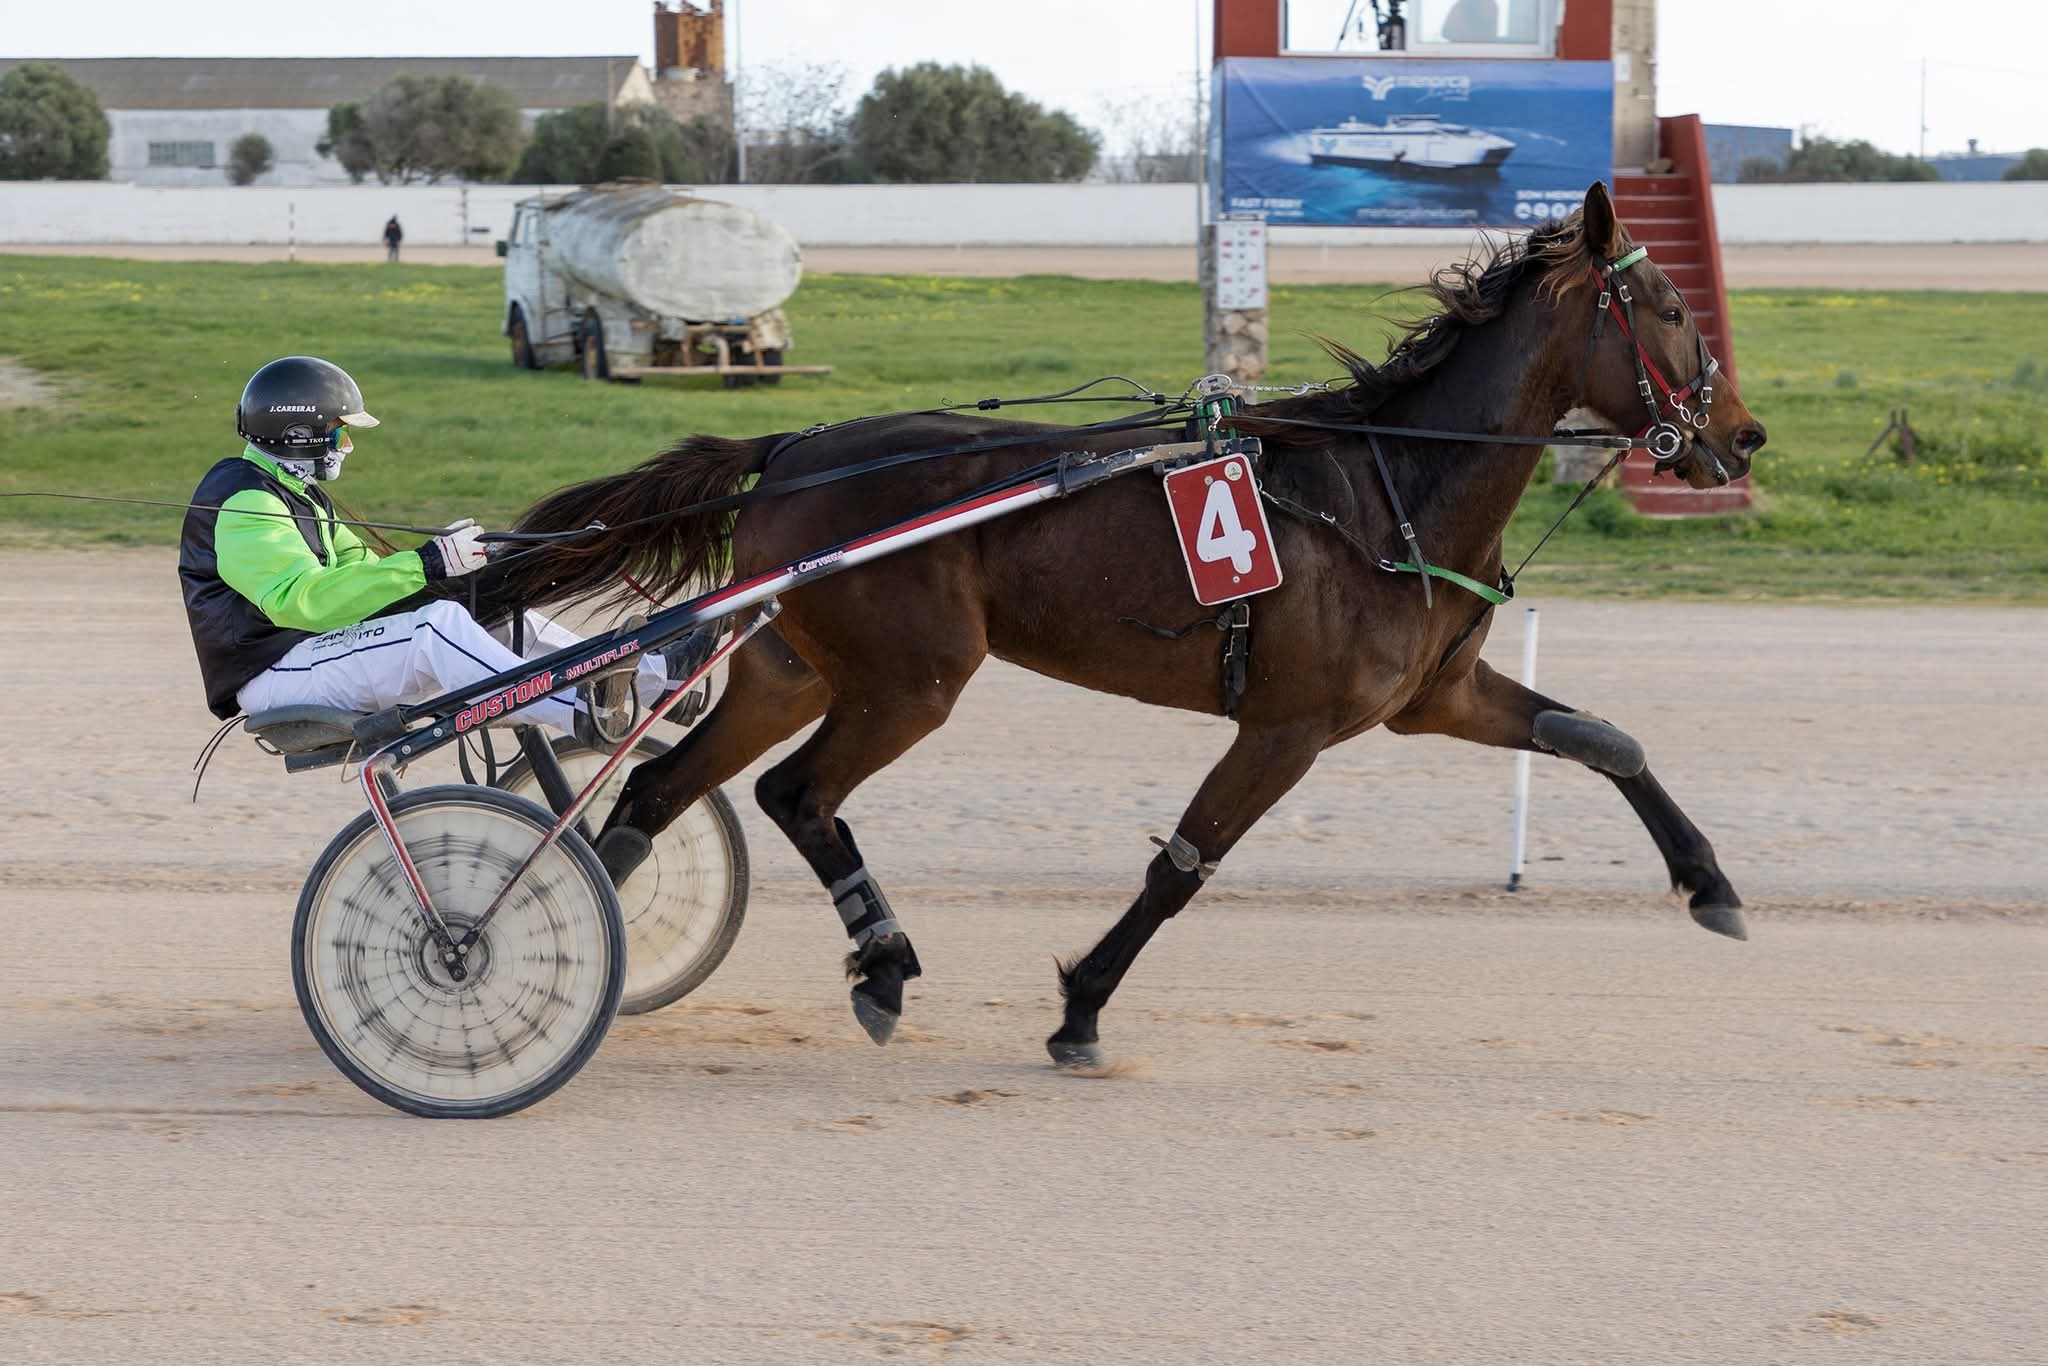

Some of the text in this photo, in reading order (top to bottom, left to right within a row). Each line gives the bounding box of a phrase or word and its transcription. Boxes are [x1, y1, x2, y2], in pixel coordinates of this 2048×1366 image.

[269, 405, 317, 413] J.CARRERAS
[1196, 479, 1257, 575] 4
[565, 639, 641, 681] MULTIFLEX
[455, 671, 553, 733] CUSTOM
